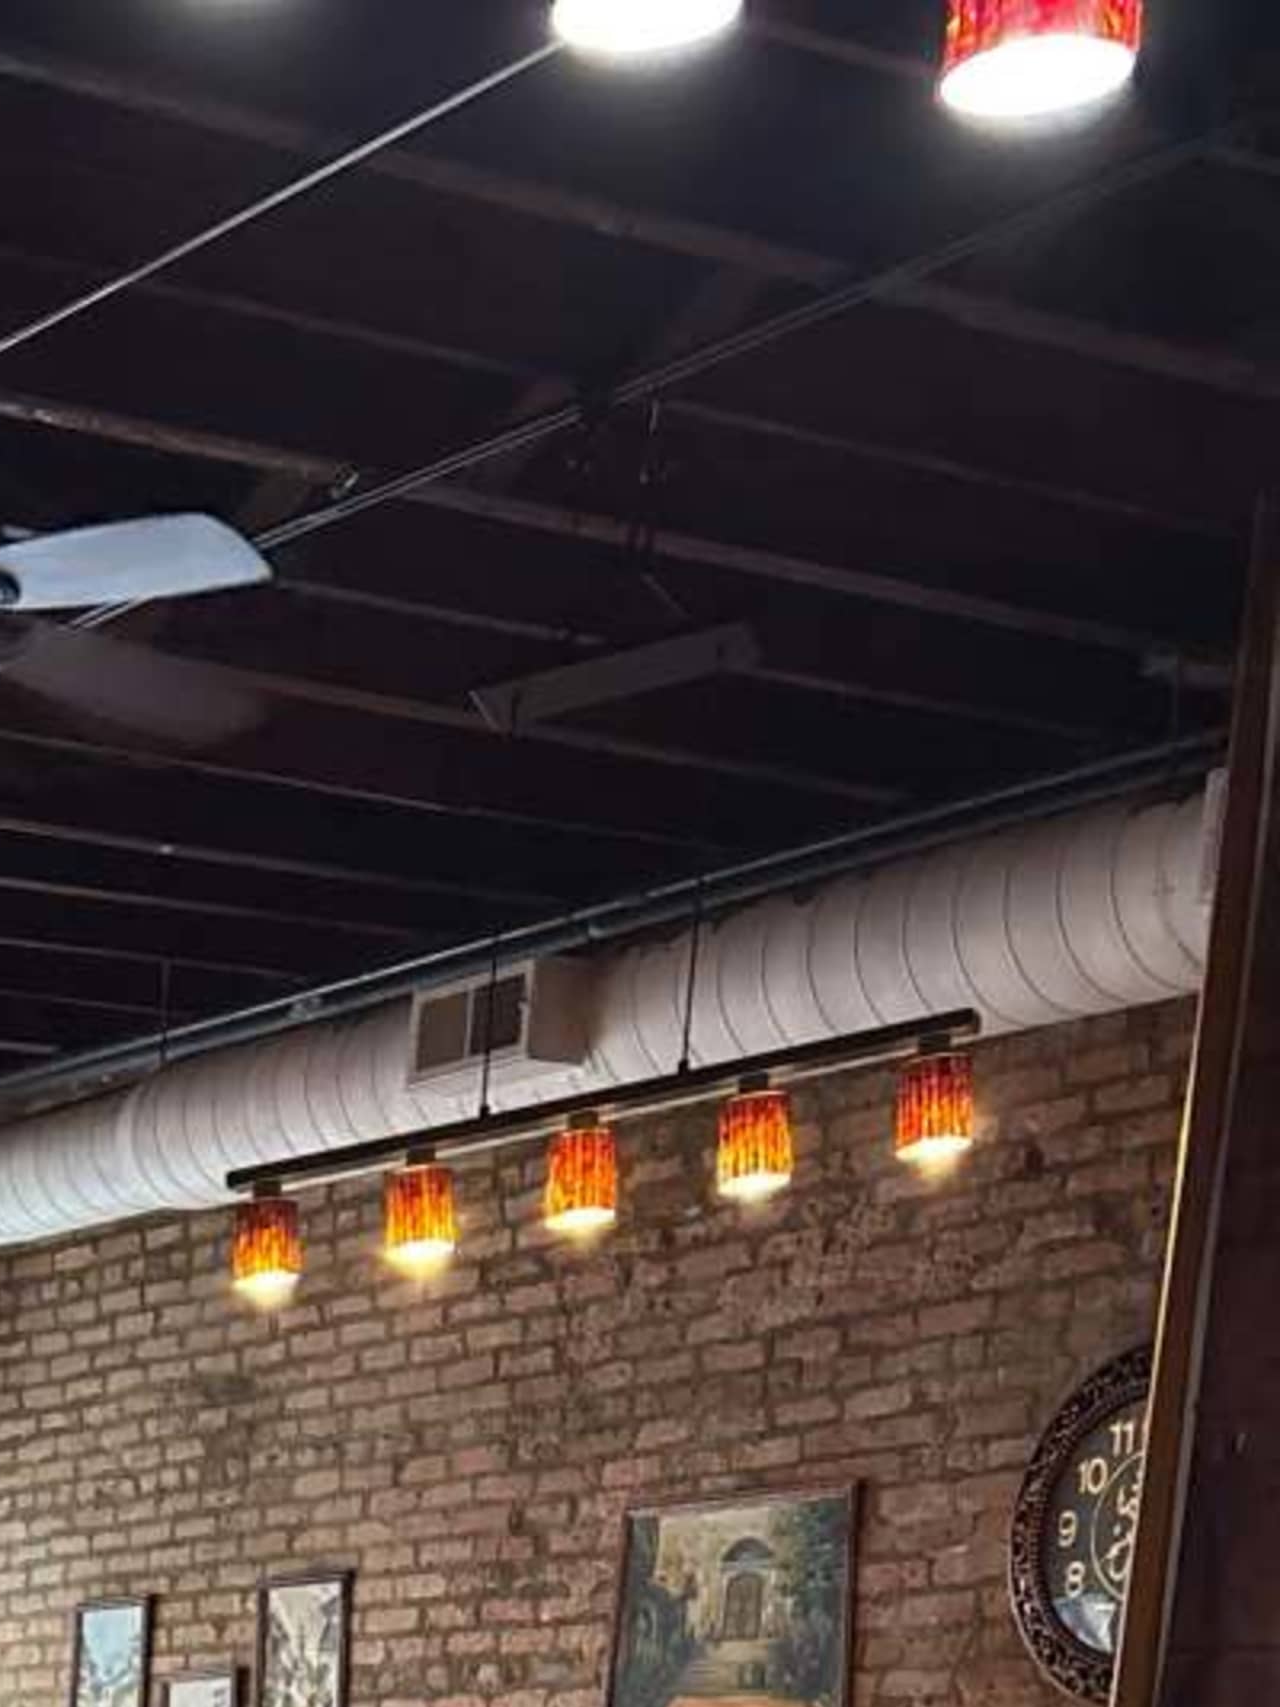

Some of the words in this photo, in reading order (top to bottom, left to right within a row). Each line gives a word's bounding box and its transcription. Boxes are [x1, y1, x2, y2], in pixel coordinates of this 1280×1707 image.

[1110, 1421, 1136, 1455] 11
[1077, 1455, 1108, 1495] 10
[1057, 1510, 1078, 1547] 9
[1064, 1561, 1085, 1599] 8
